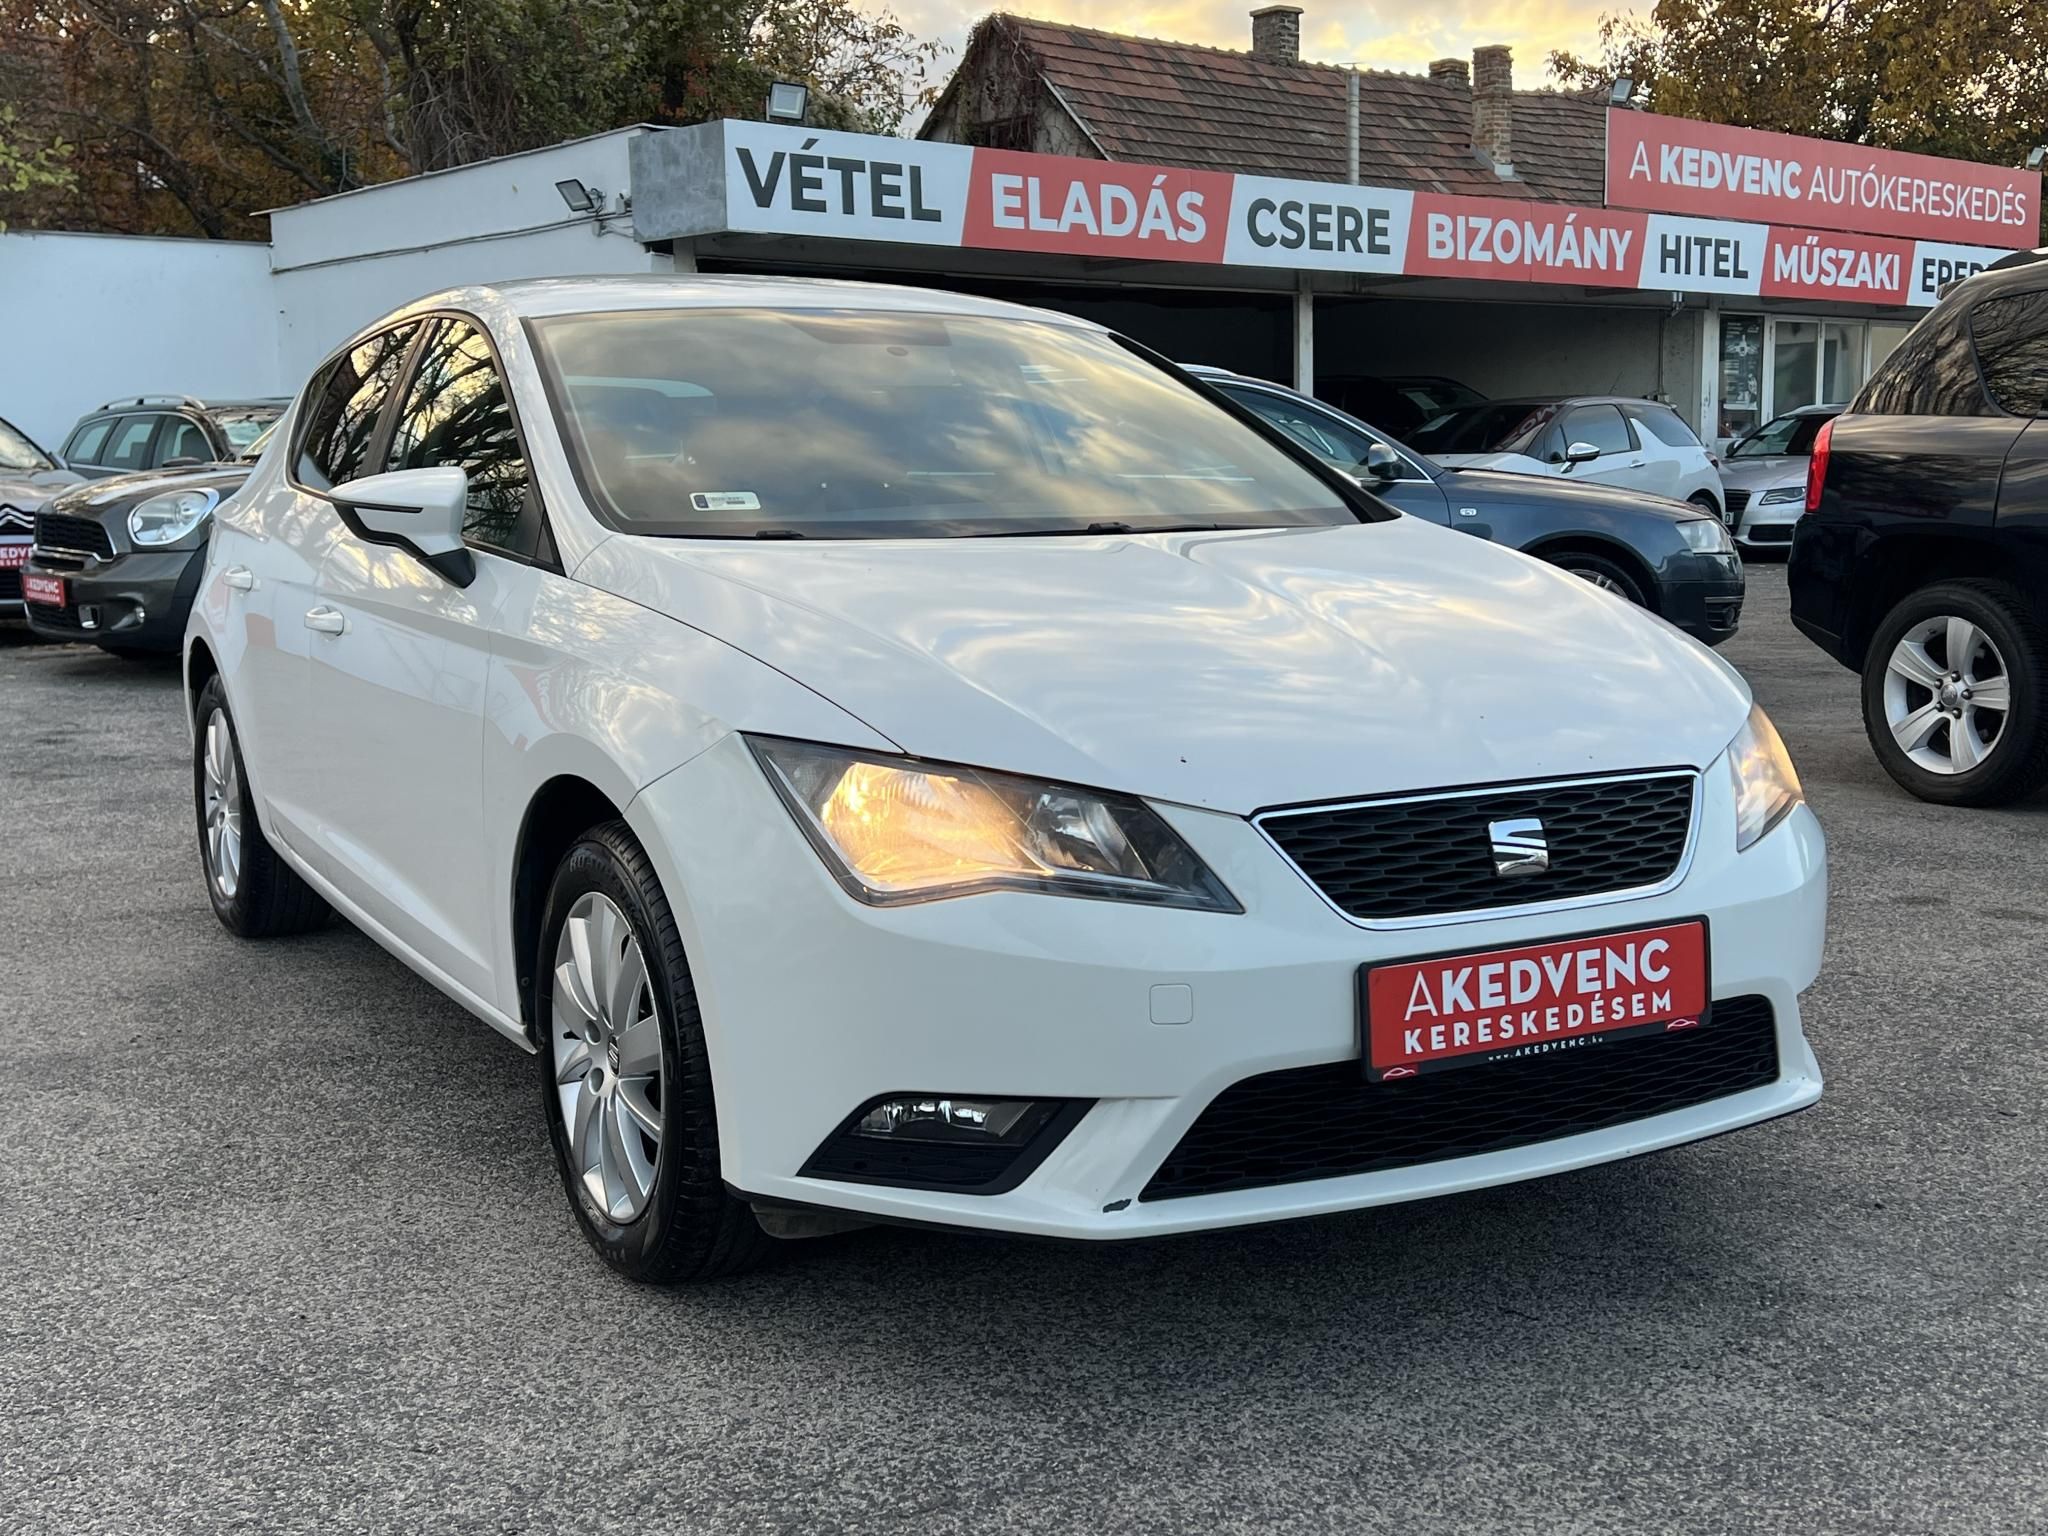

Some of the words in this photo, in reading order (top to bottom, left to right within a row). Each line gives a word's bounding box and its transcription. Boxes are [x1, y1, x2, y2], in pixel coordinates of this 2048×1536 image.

[735, 138, 942, 223] VÉTEL
[991, 173, 1208, 244] ELADÁS
[1628, 140, 1652, 182] A
[1659, 143, 1803, 200] KEDVENC
[1807, 163, 2028, 227] AUTÓKERESKEDÉS
[1246, 197, 1391, 255] CSERE
[1427, 212, 1633, 272] BIZOMÁNY
[1659, 233, 1749, 280] HITEL
[1773, 236, 1900, 292] MŰSZAKI
[1403, 989, 1672, 1056] KERESKEDÉSEM
